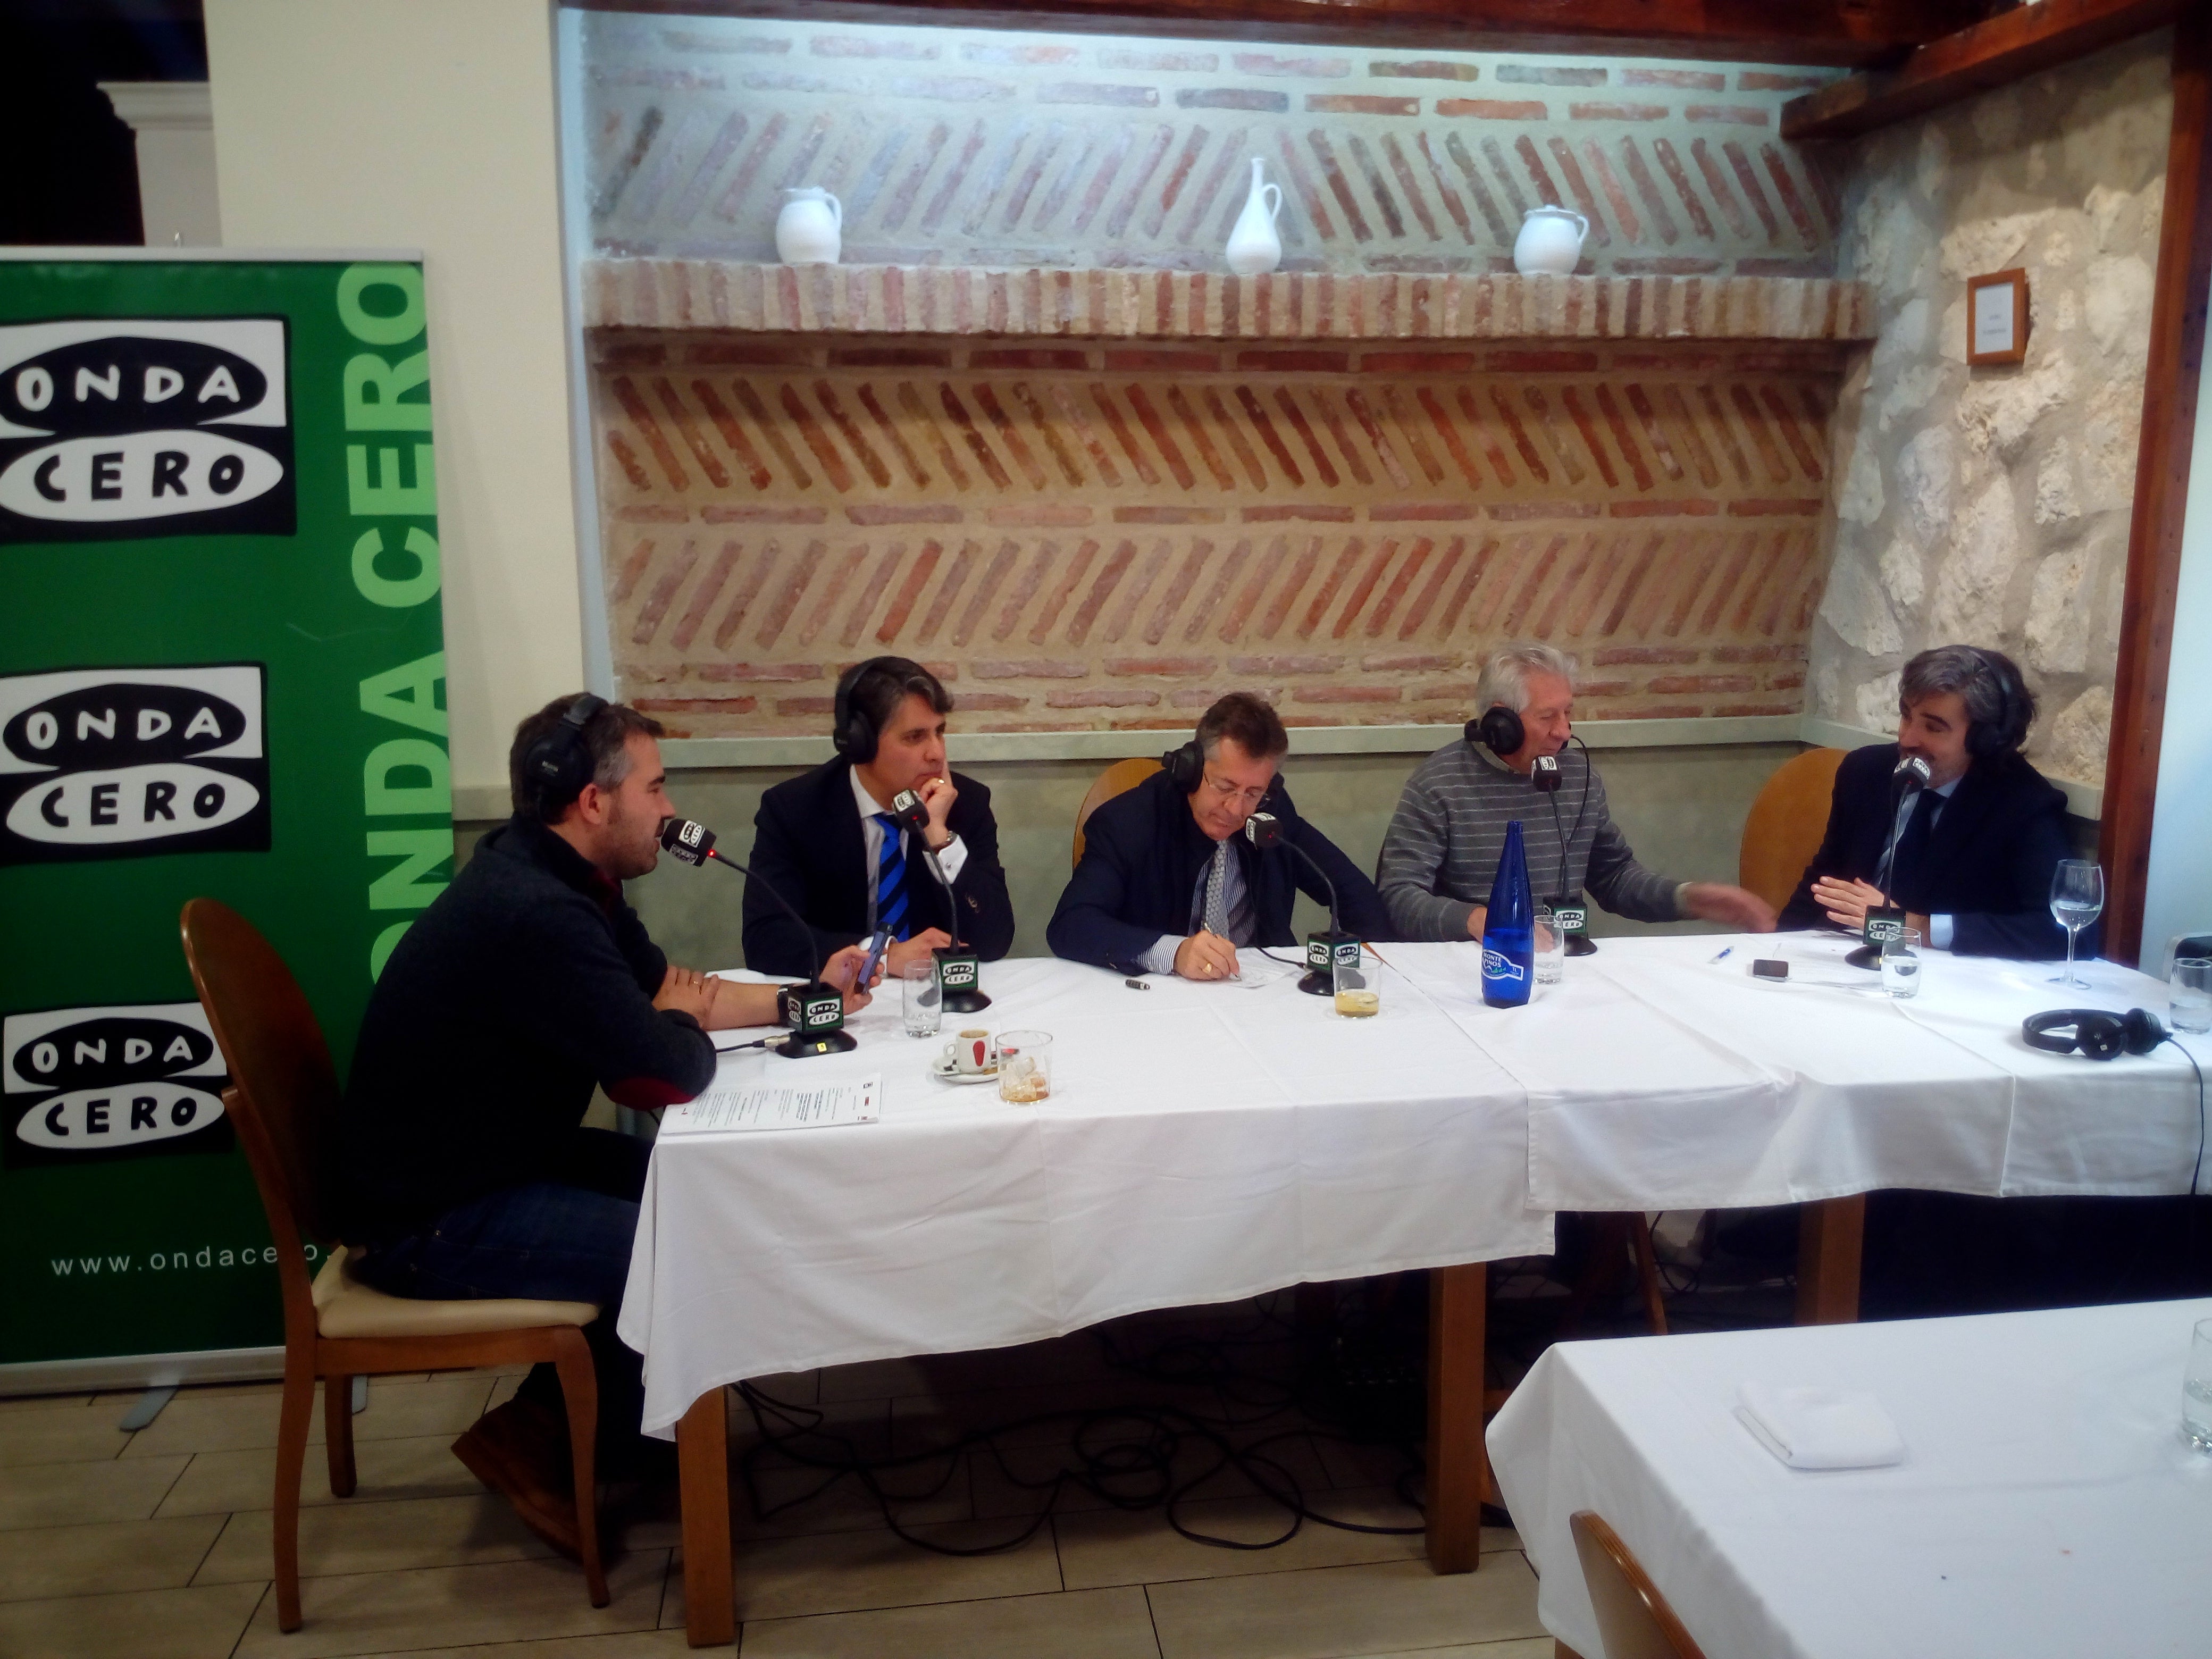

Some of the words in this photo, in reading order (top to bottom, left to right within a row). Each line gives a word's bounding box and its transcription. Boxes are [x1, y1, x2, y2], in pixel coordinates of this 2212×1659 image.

[16, 364, 240, 412] ONDA
[337, 262, 442, 608] CERO
[33, 450, 245, 502] CERO
[26, 707, 222, 750] ONDA
[40, 781, 225, 827] CERO
[1484, 952, 1502, 962] MONTE
[1484, 958, 1502, 968] PINOS
[811, 1004, 836, 1012] ONDA
[813, 1014, 835, 1023] CERO
[32, 1035, 193, 1073] ONDA
[45, 1096, 197, 1136] CERO
